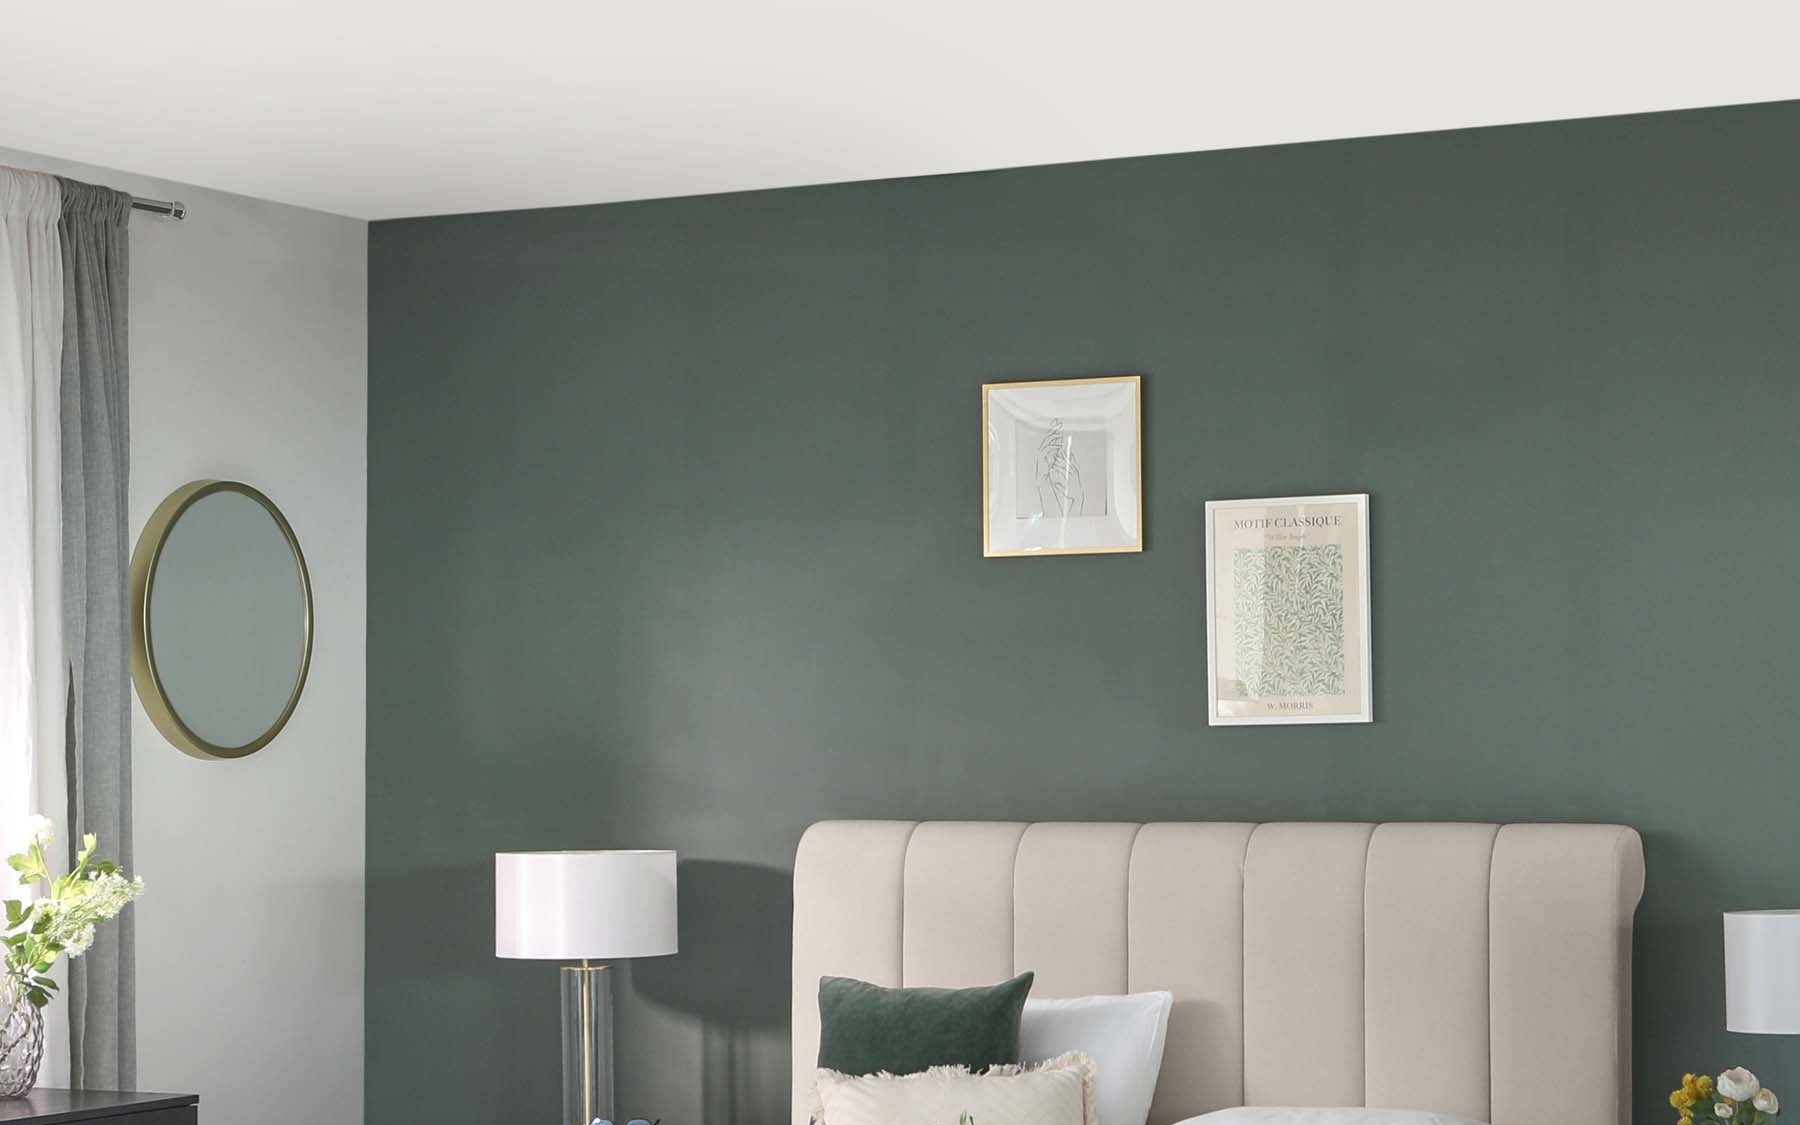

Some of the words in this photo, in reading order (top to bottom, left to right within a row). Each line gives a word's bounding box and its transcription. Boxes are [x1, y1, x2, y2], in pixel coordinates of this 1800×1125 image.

[1233, 519, 1272, 529] MOTIF
[1274, 515, 1342, 527] CLASSIQUE
[1279, 701, 1313, 711] MORRIS
